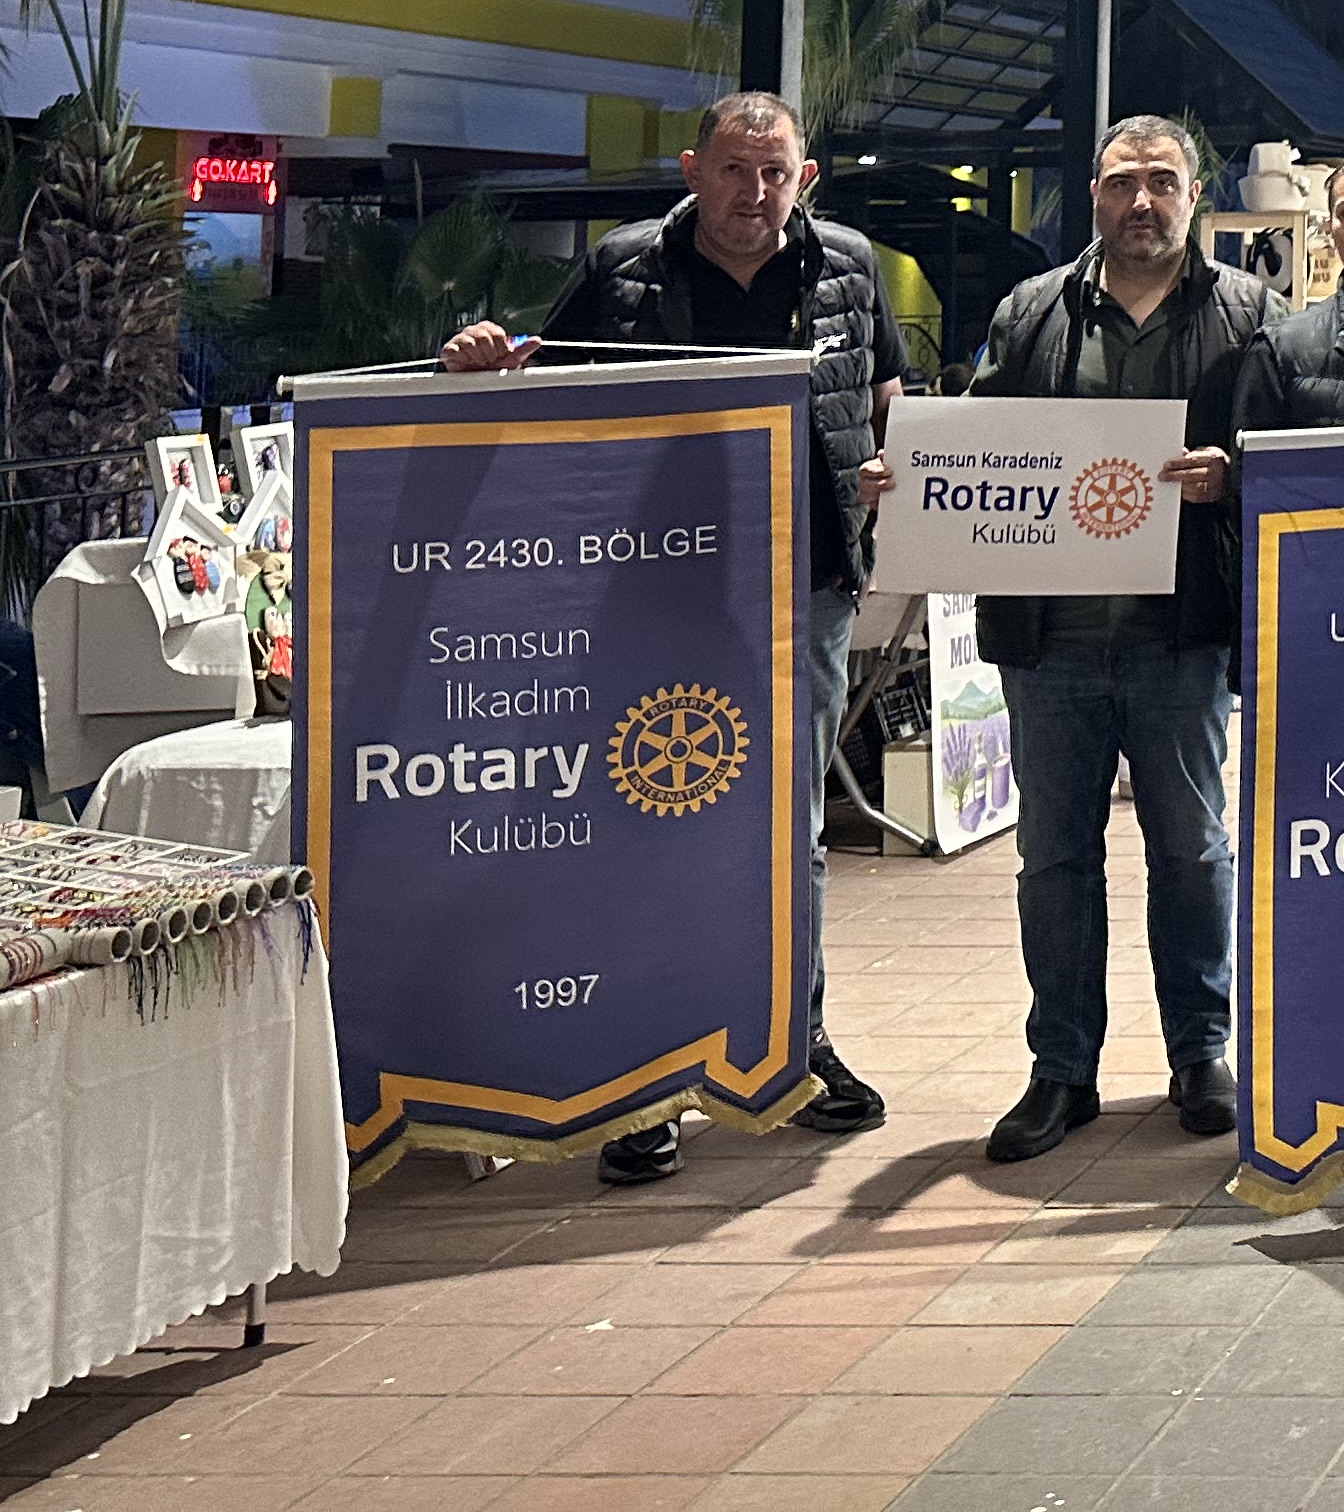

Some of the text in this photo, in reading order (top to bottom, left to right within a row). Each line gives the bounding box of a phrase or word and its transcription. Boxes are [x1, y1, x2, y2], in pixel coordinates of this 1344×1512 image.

[911, 451, 1062, 469] Samsun Karadeniz
[923, 477, 1059, 520] Rotary
[394, 525, 717, 573] UR 2430. BÖLGE
[973, 522, 1055, 544] Kulübü
[430, 628, 589, 663] Samsun
[447, 679, 589, 719] İlkadım
[650, 697, 708, 717] ROTARY
[357, 744, 589, 801] Rotary
[629, 761, 730, 803] INTERNATIONAL
[451, 813, 590, 855] Kulübü
[515, 975, 599, 1009] 1997
